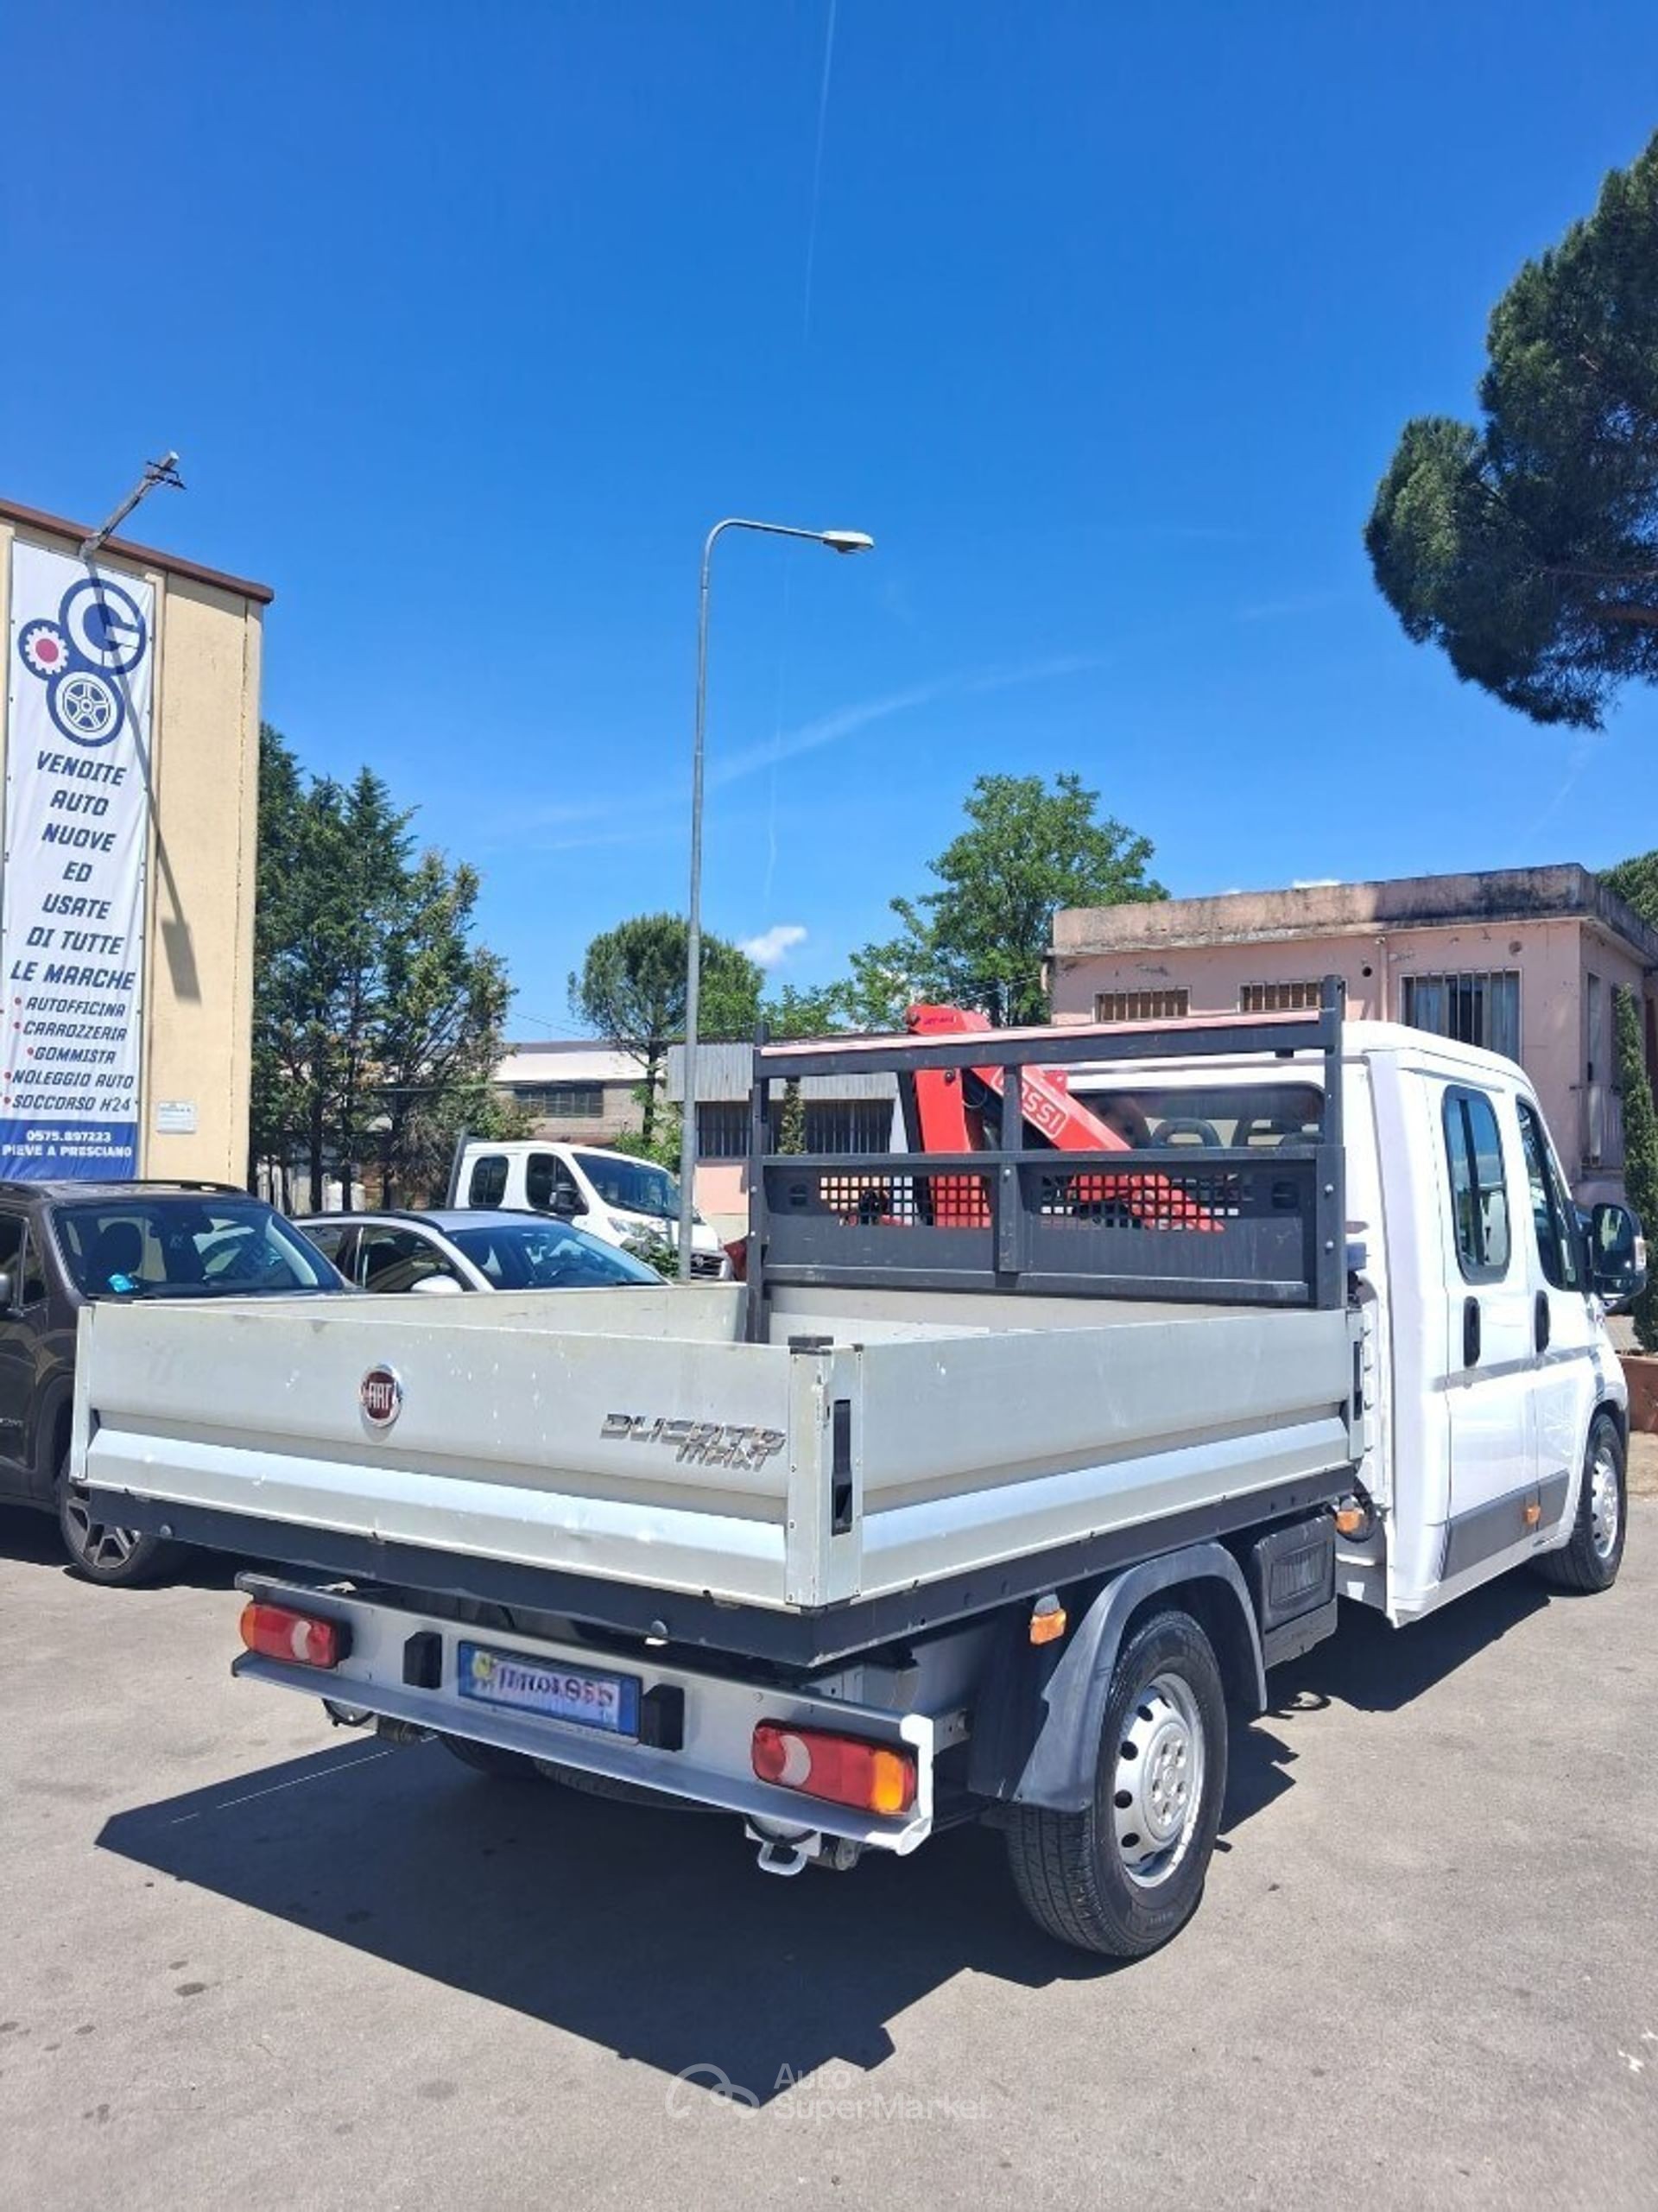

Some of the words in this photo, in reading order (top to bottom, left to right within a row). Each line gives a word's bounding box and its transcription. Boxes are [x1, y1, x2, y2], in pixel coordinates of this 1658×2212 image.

[37, 751, 127, 787] VENDITE
[50, 789, 109, 816] AUTO
[41, 822, 117, 852] NUOVE
[62, 860, 92, 882] ED
[41, 893, 111, 919] USATE
[26, 926, 55, 948] DI
[60, 930, 124, 954] TUTTE
[9, 960, 38, 981] LE
[44, 963, 136, 990] MARCHE
[25, 997, 125, 1017] AUTOFFICINA
[23, 1020, 127, 1041] CARROZZERIA
[34, 1046, 116, 1063] GOMMISTA
[12, 1069, 92, 1087] NOLEGGIO
[95, 1074, 134, 1089] AUTO
[12, 1094, 96, 1111] SOCCORSO
[100, 1097, 131, 1112] H24
[2, 1144, 42, 1156] PIEVE
[47, 1145, 56, 1156] A
[60, 1146, 132, 1157] PRESCIANO
[601, 1413, 786, 1456] DUCATO
